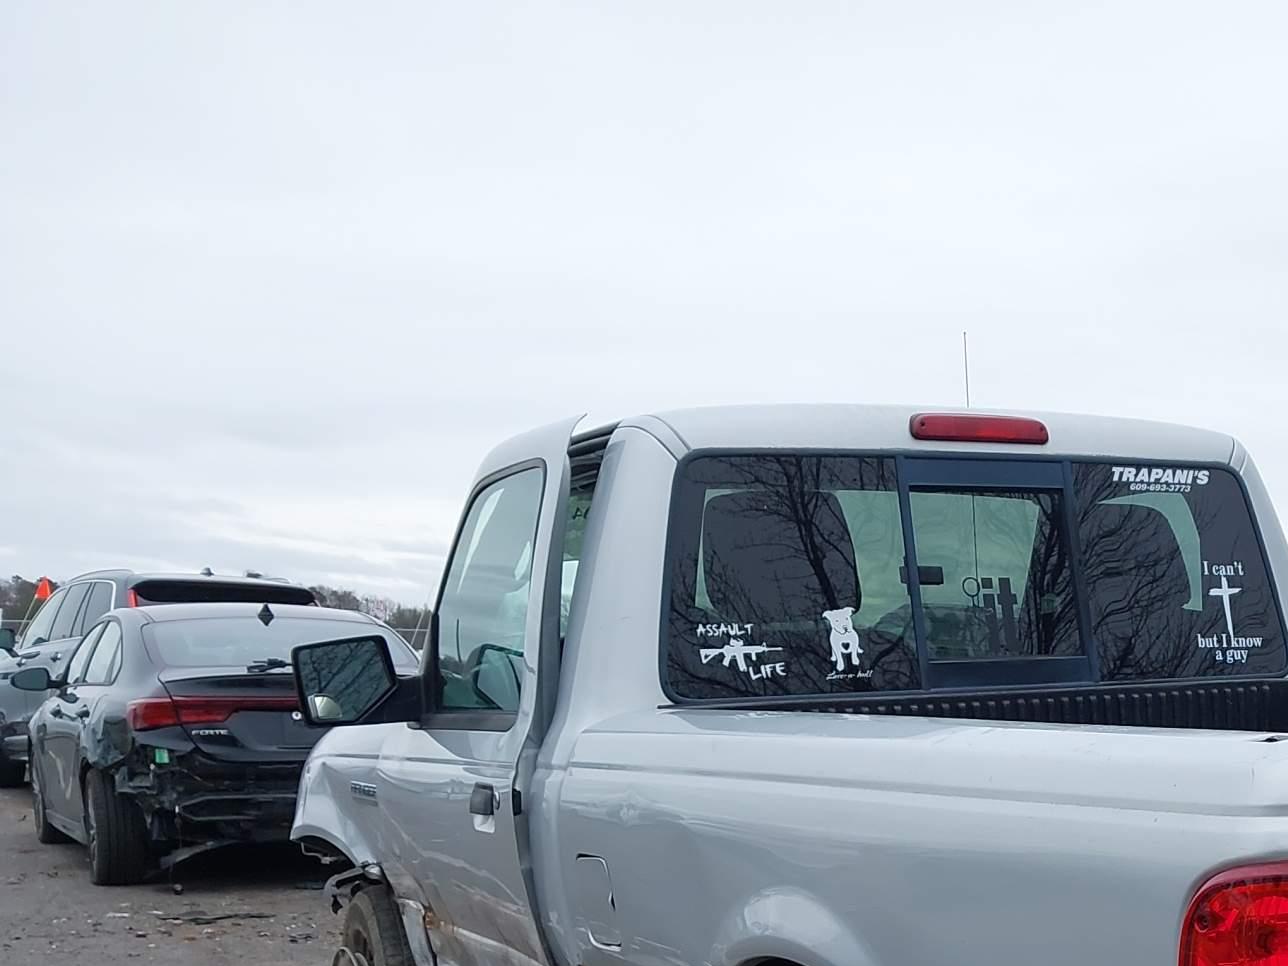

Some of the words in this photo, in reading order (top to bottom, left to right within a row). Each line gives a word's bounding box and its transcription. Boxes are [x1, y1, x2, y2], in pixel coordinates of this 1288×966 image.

[1111, 466, 1210, 485] TRAPANI'S
[1129, 483, 1192, 493] 609-693-3773
[1202, 560, 1210, 576] I
[1212, 561, 1244, 576] can't
[696, 623, 754, 637] ASSAULT
[1197, 633, 1219, 648] but
[1221, 633, 1229, 648] I
[1231, 635, 1263, 648] know
[1215, 650, 1223, 661] a
[1226, 649, 1248, 663] guy
[749, 662, 787, 680] LIFE
